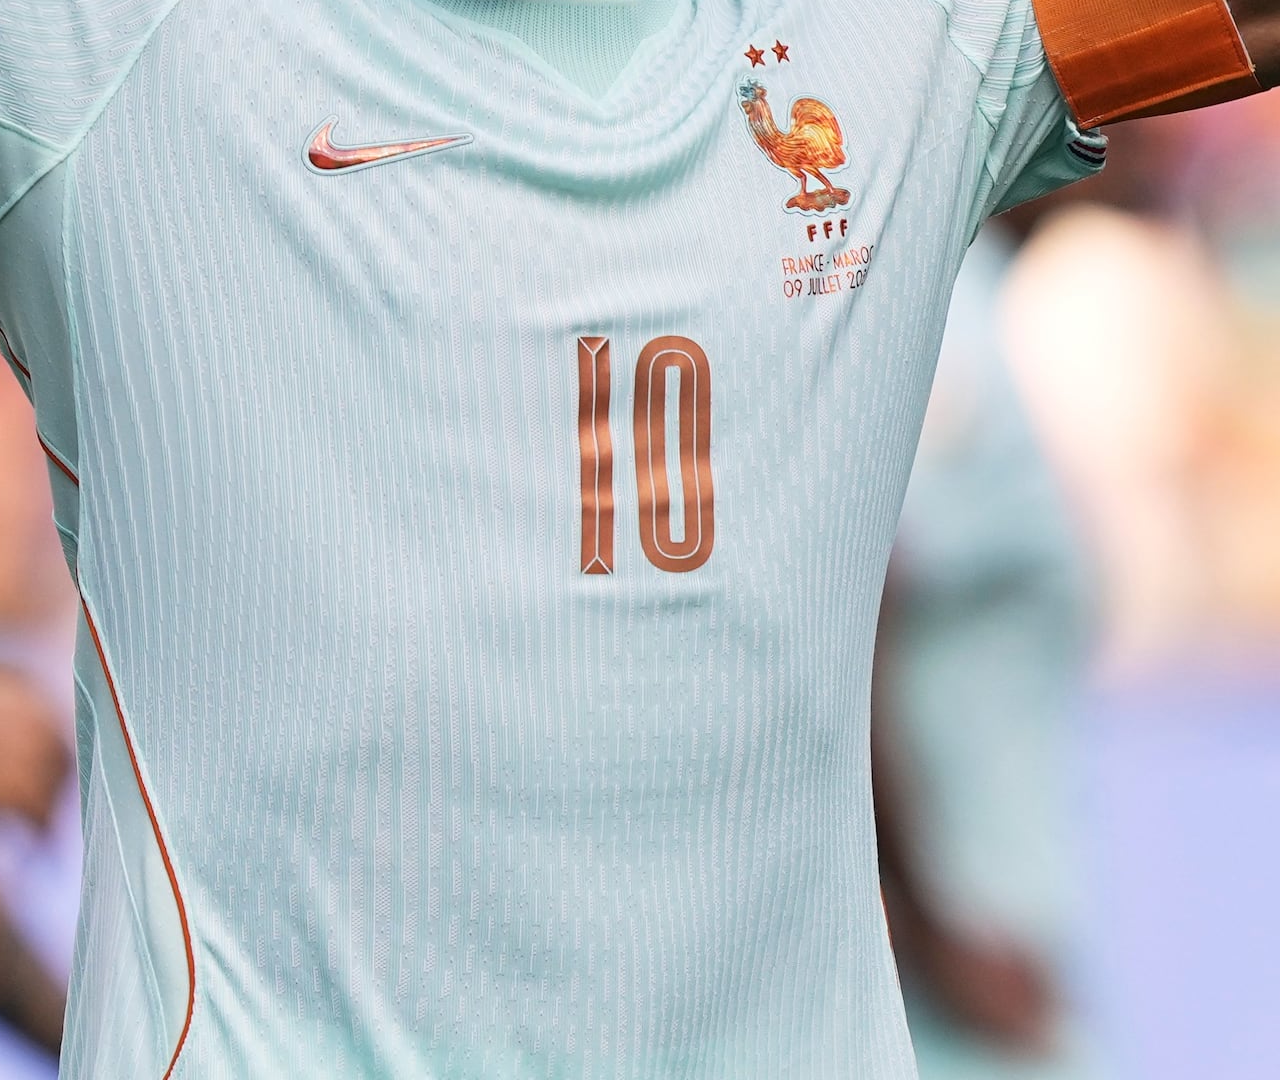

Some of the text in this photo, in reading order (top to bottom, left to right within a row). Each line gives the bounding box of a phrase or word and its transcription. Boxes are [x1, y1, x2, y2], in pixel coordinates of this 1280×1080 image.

[806, 219, 848, 242] FFF
[782, 254, 824, 276] FRANCE
[783, 279, 803, 298] 09
[577, 335, 715, 575] 10
